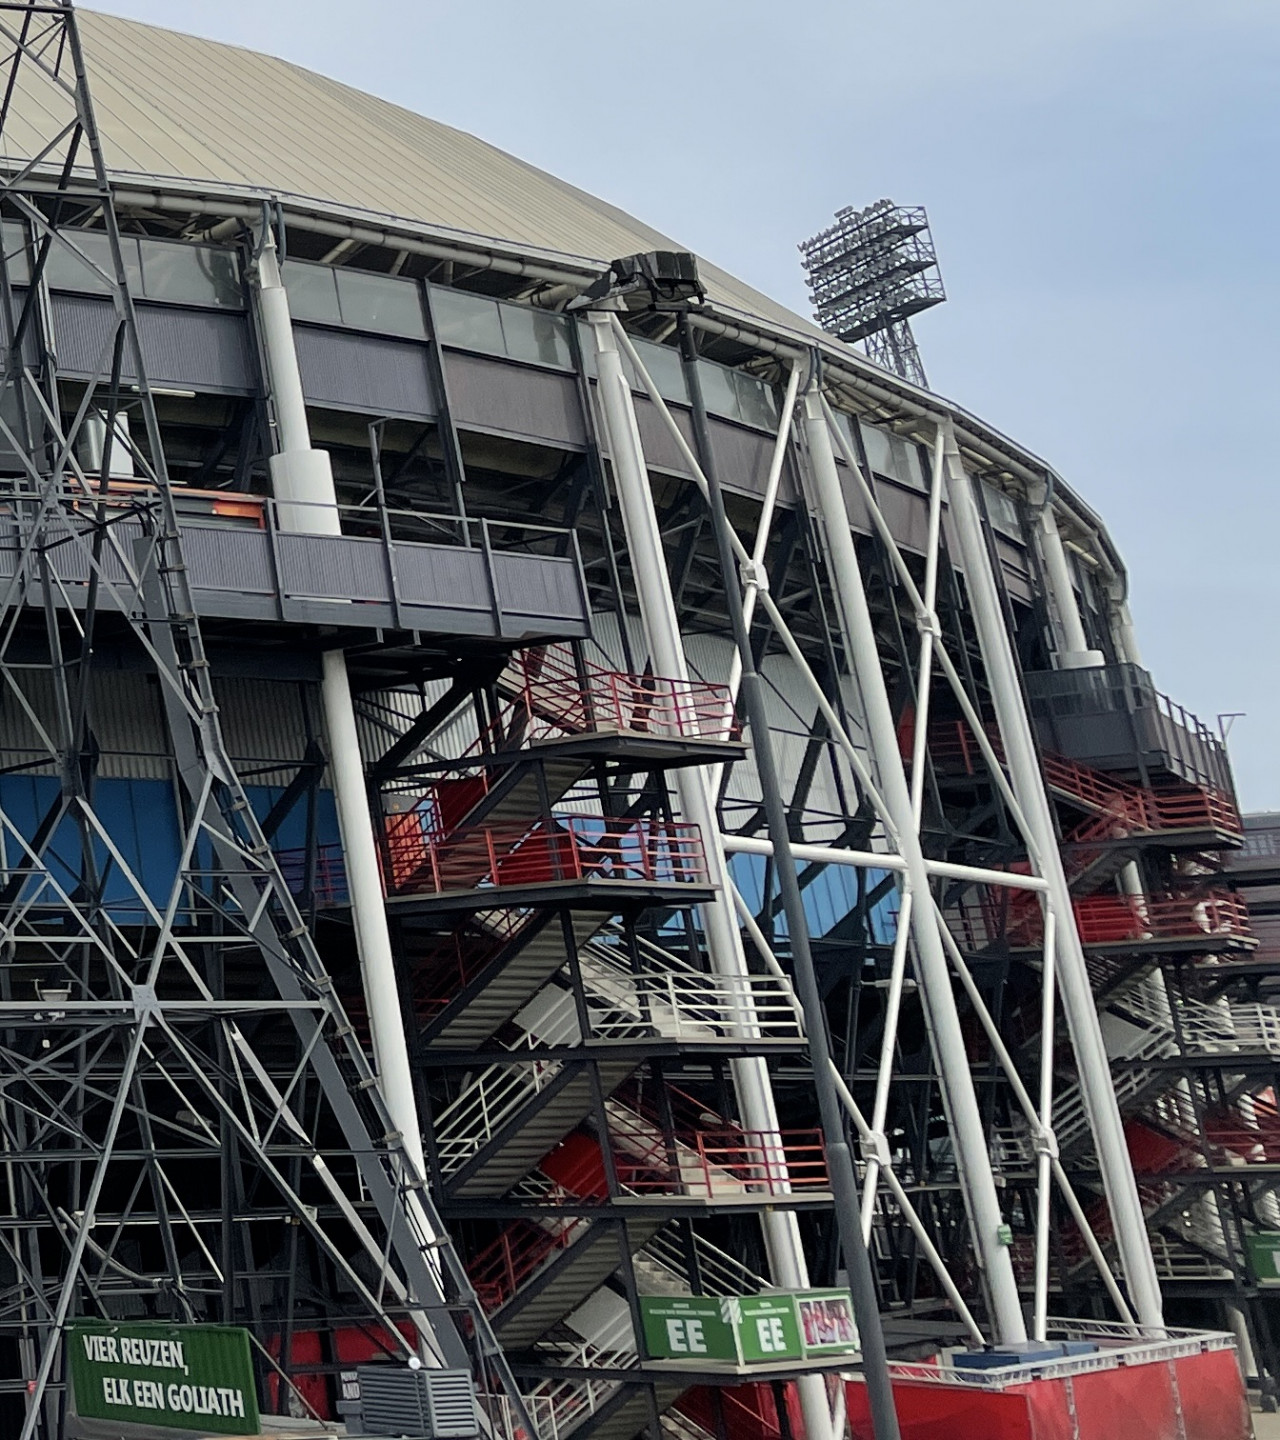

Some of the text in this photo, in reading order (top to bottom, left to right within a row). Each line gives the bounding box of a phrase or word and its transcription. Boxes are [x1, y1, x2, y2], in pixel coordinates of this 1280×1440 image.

[665, 1319, 708, 1353] EE
[756, 1317, 787, 1353] EE
[82, 1334, 189, 1376] VIER REUZEN,
[102, 1377, 246, 1419] ELK EEN GOLIATH
